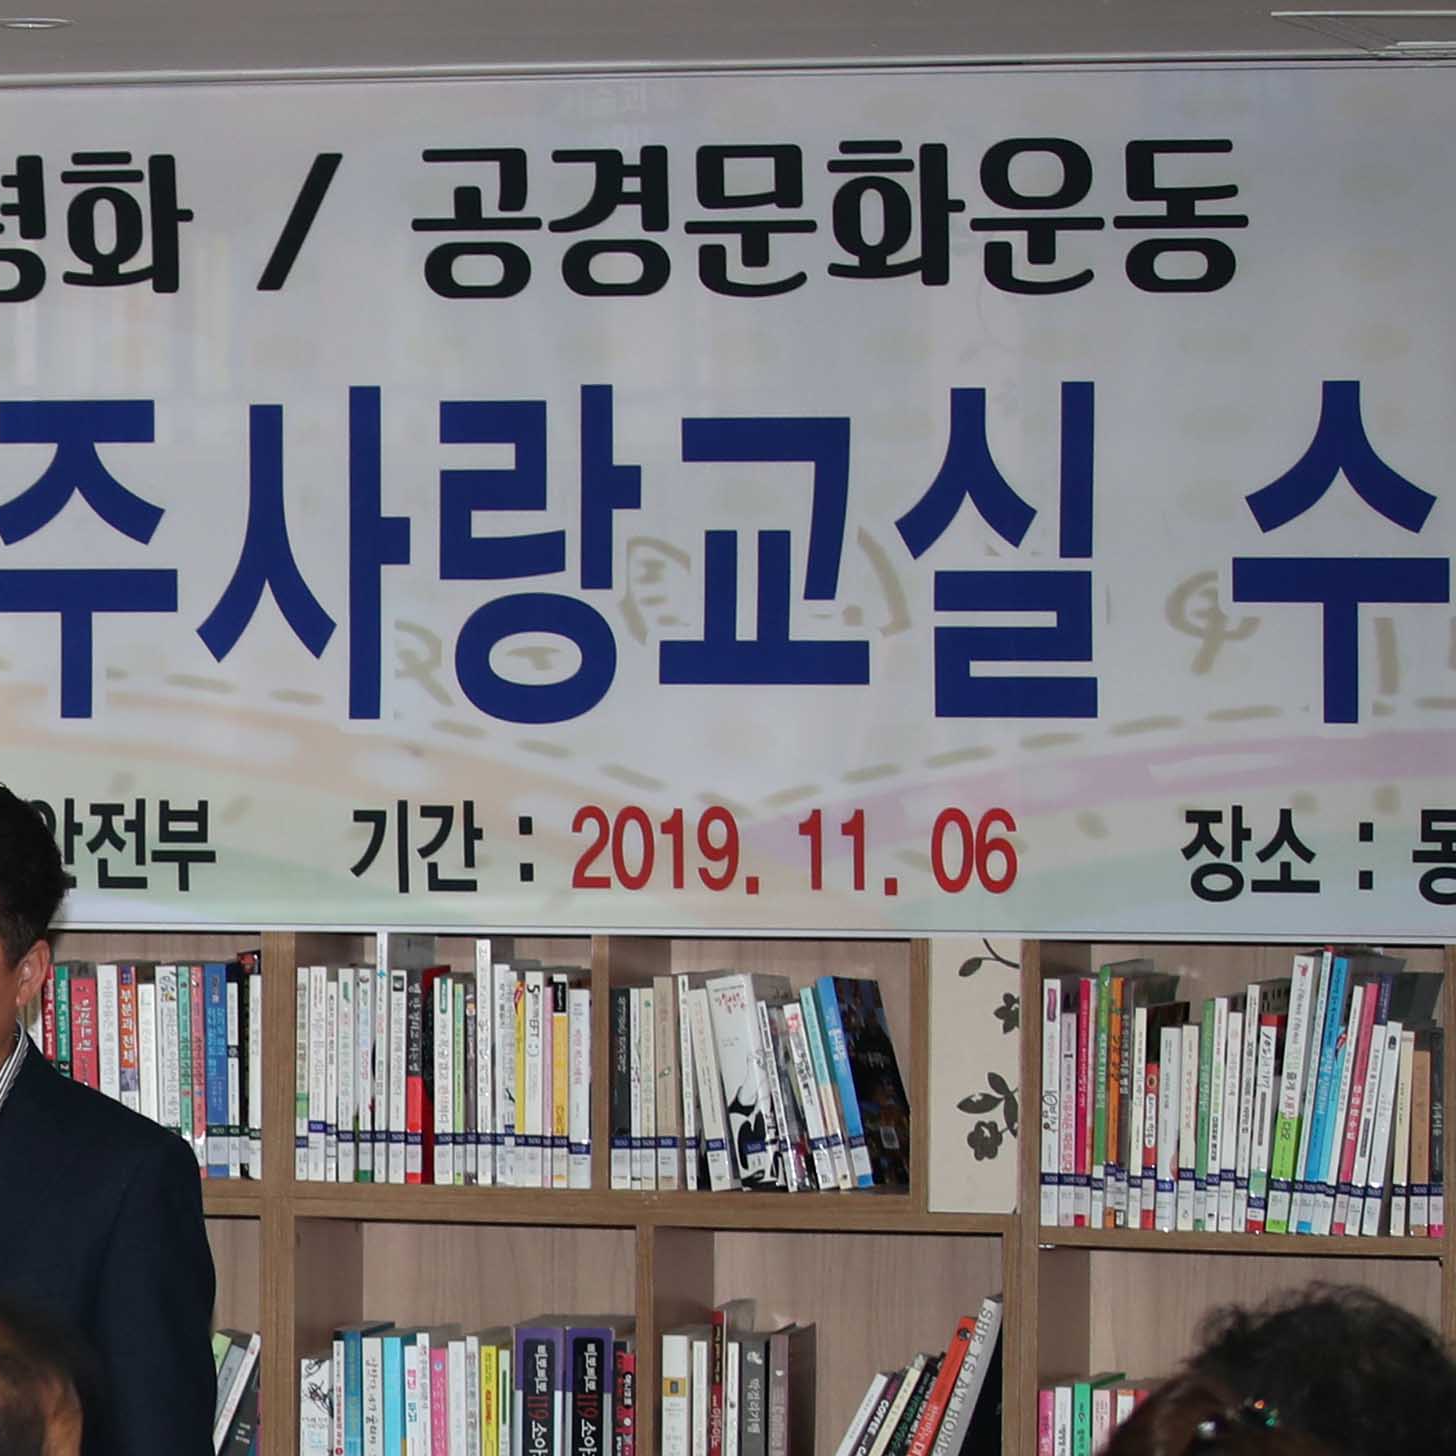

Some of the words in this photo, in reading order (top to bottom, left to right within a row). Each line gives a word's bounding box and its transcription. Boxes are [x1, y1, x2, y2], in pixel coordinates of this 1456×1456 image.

[411, 137, 1249, 299] 공경문화운동
[1231, 380, 1450, 724] 수
[350, 799, 483, 894] 기간
[572, 805, 760, 895] 2019.
[799, 809, 898, 896] 11.
[931, 807, 1018, 894] 06
[1181, 805, 1321, 902] 장소
[974, 1307, 993, 1345] SHE
[527, 1394, 549, 1421] 119
[576, 1392, 599, 1419] 119
[869, 1399, 889, 1436] COFFEE
[938, 1407, 960, 1455] HOME
